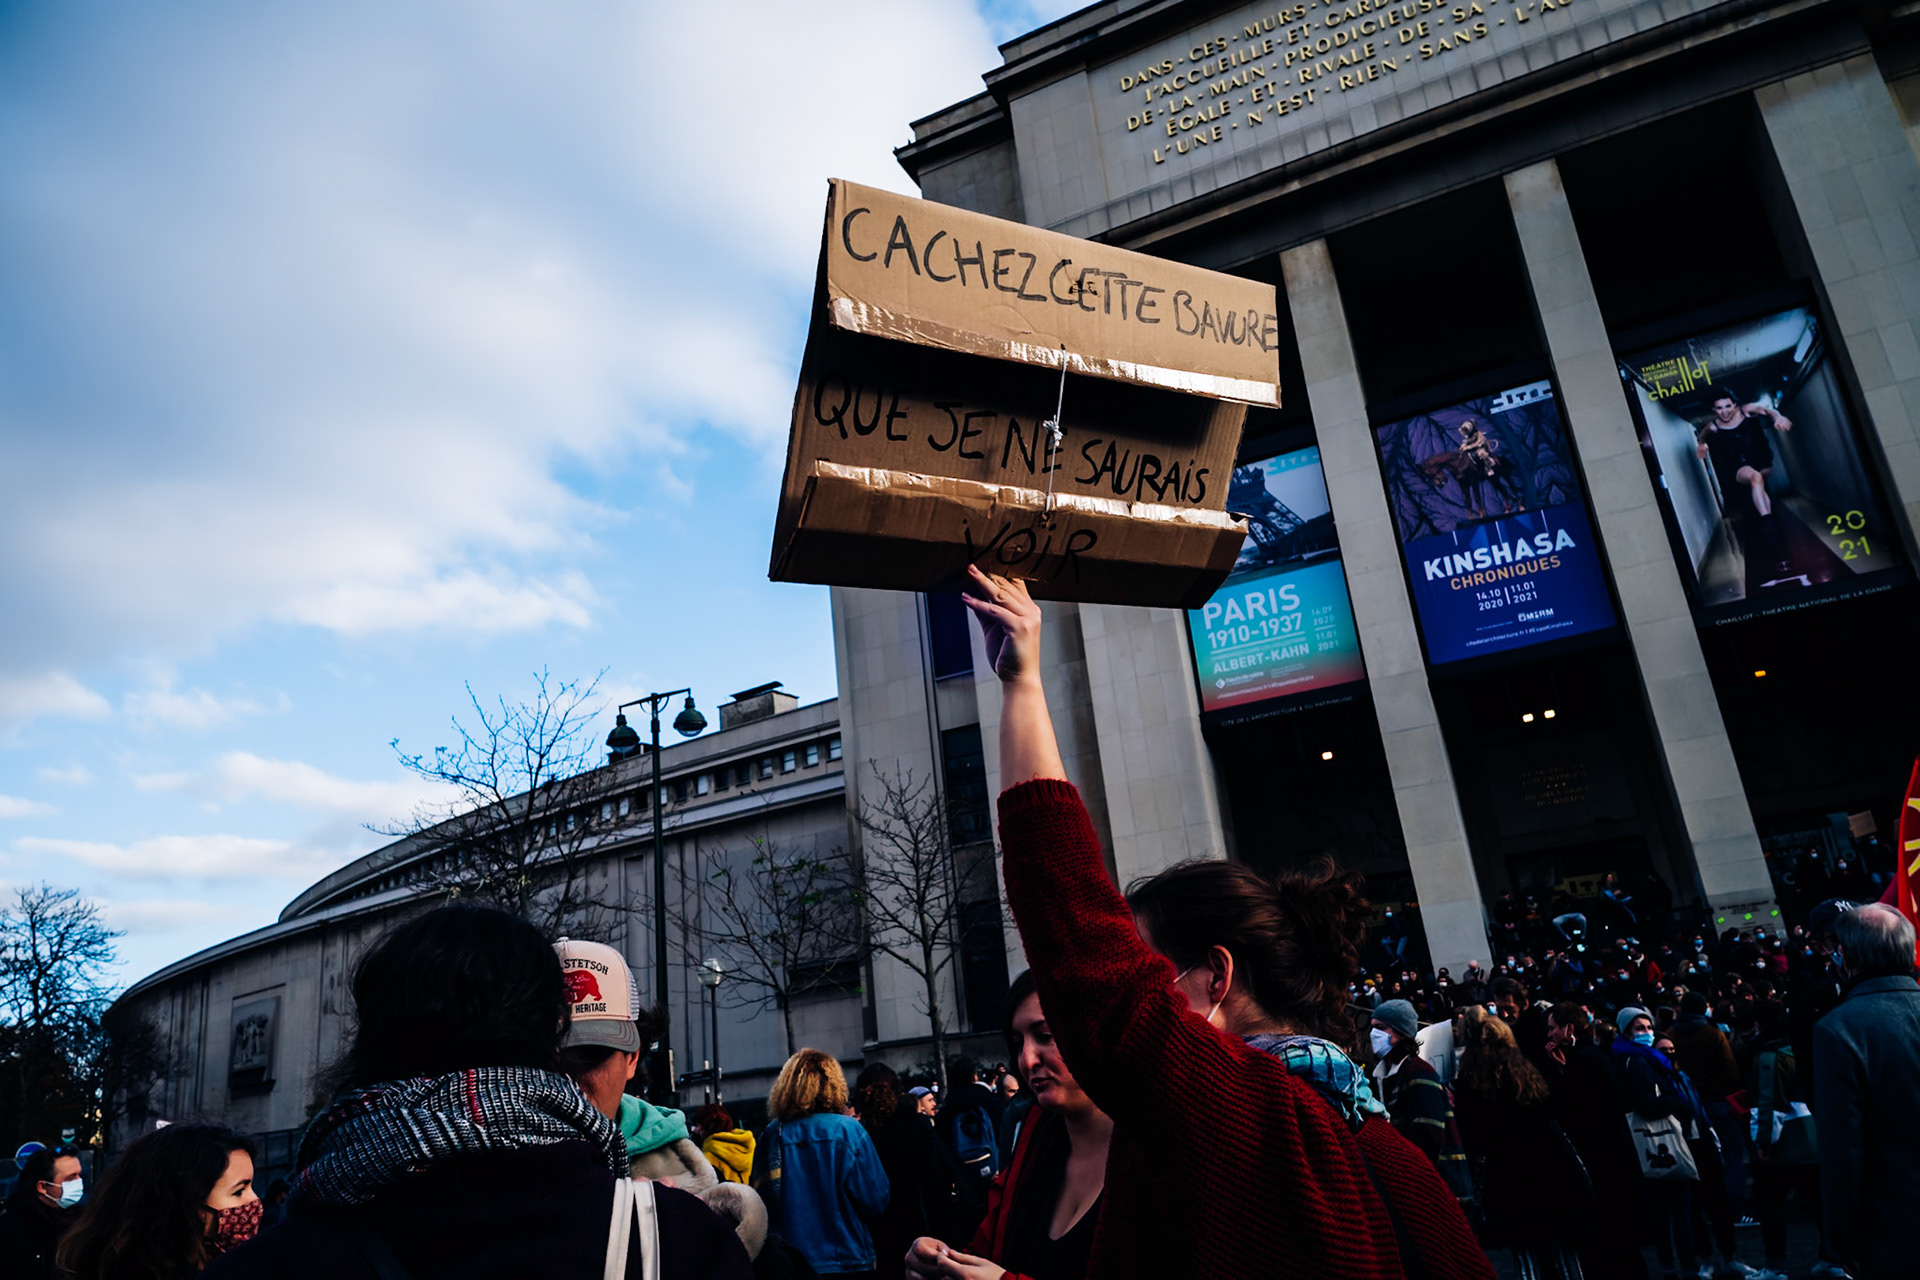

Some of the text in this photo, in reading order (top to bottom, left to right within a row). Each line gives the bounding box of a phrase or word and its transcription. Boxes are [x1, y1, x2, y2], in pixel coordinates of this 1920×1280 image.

[1287, 23, 1311, 45] ET
[1325, 0, 1400, 28] GARD
[1120, 4, 1306, 92] DANS CES MURS
[1166, 2, 1484, 137] ÉGALE ET RIVALE DE SA
[1127, 110, 1153, 131] DE
[1169, 95, 1194, 114] LA
[1209, 64, 1266, 98] MAIN
[1153, 126, 1223, 164] L'UNE
[1247, 88, 1315, 127] N'EST
[1339, 57, 1398, 91] RIEN
[1420, 22, 1488, 60] SANS
[842, 207, 1279, 353] CACHEZ CETTE BAVURE
[813, 369, 908, 441] QUE
[927, 402, 998, 459] JE
[1001, 416, 1068, 476] NE
[1826, 510, 1866, 536] 20
[1423, 528, 1576, 581] KINSHASA
[1839, 536, 1871, 561] 21
[1450, 555, 1561, 590] CHRONIQUES
[1476, 581, 1535, 601] 14.10 11.01
[1203, 584, 1301, 630] PARIS
[1478, 591, 1538, 611] 2020 2021
[1208, 612, 1303, 649] 1910-1937
[1213, 643, 1310, 674] ALBERT-KAHN
[563, 958, 609, 975] STETSON
[575, 1002, 607, 1013] HERITAGE
